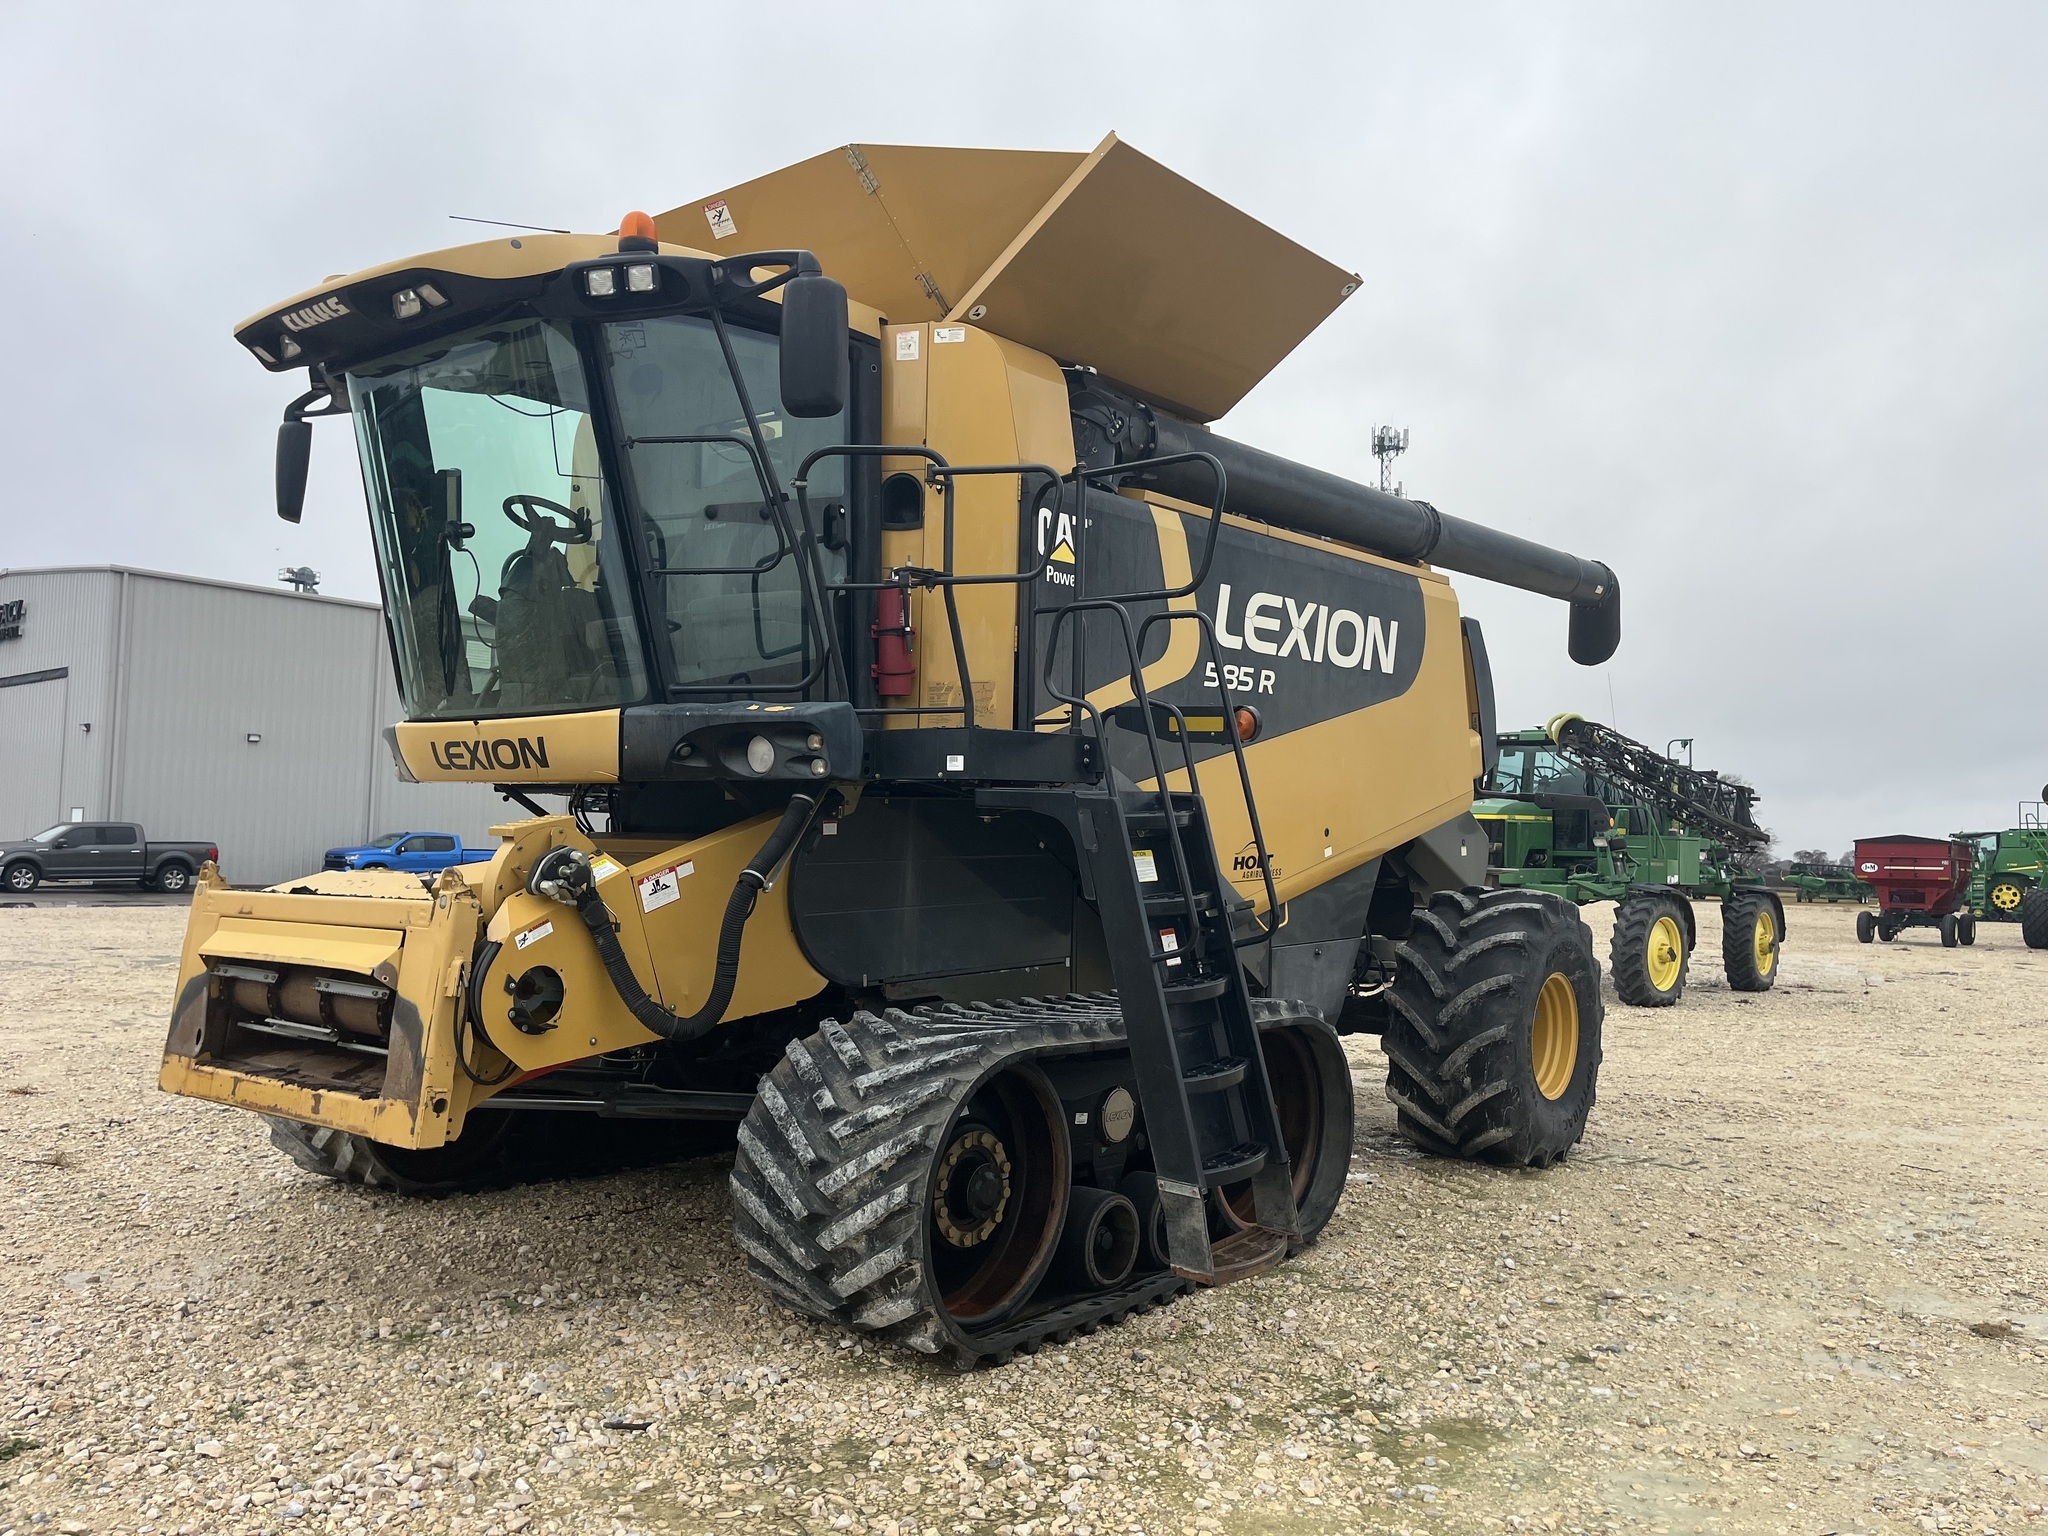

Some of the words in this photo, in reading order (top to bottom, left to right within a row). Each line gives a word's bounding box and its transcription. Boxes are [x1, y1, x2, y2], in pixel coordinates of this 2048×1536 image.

[281, 296, 350, 332] CLAAS
[1046, 564, 1075, 587] Powe
[1214, 583, 1399, 674] LEXION
[1203, 661, 1255, 692] 585
[1258, 669, 1276, 695] R
[430, 736, 550, 770] LEXION
[648, 868, 670, 881] DANGER
